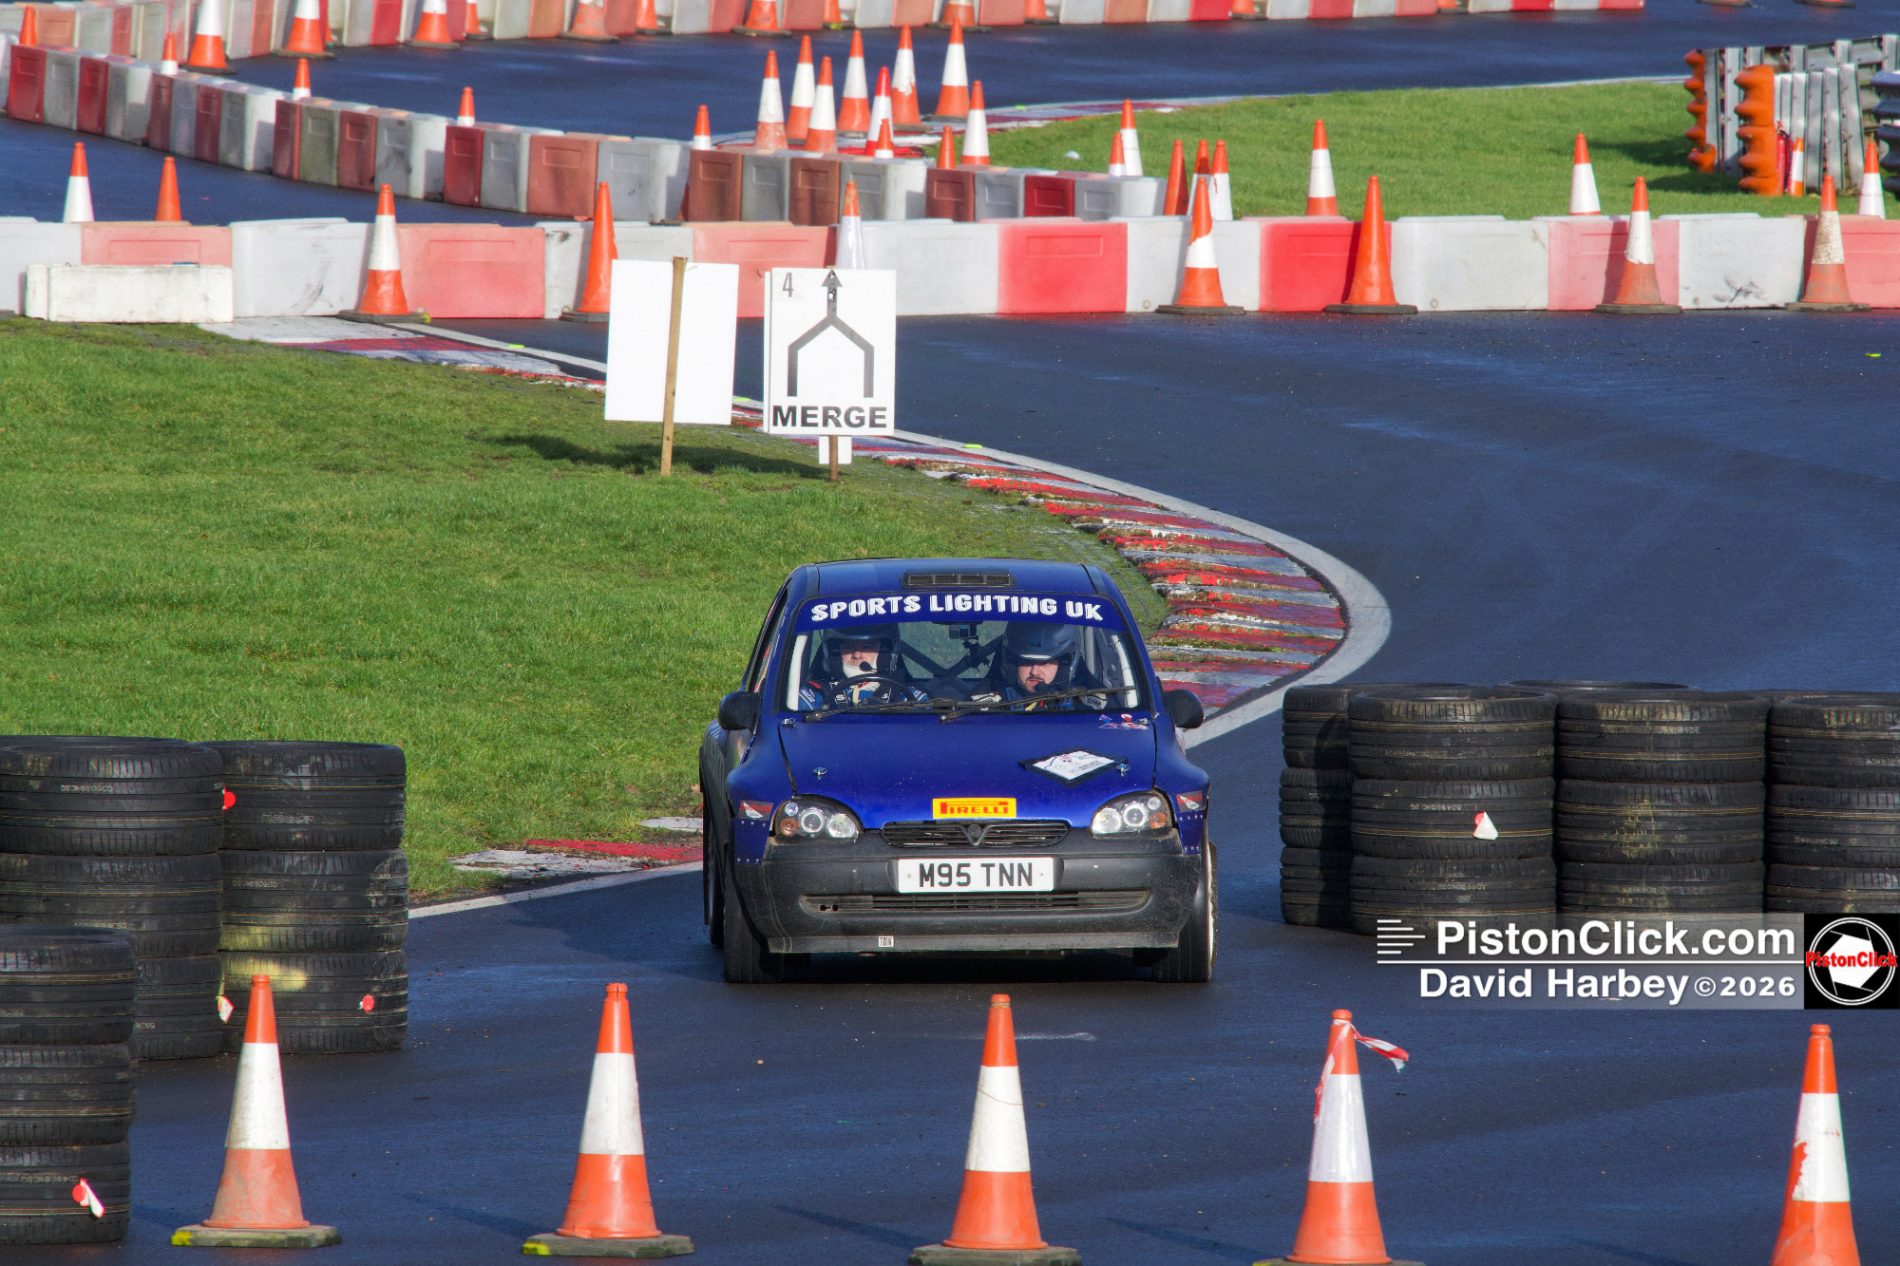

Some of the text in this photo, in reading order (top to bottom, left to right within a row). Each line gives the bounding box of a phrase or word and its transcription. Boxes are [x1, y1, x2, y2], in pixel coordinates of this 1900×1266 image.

[782, 272, 794, 298] 4
[772, 405, 888, 429] MERGE
[811, 594, 1104, 622] SPORTS LIGHTING UK
[940, 801, 1009, 815] PIRELLI
[919, 862, 1033, 888] M95 TNN
